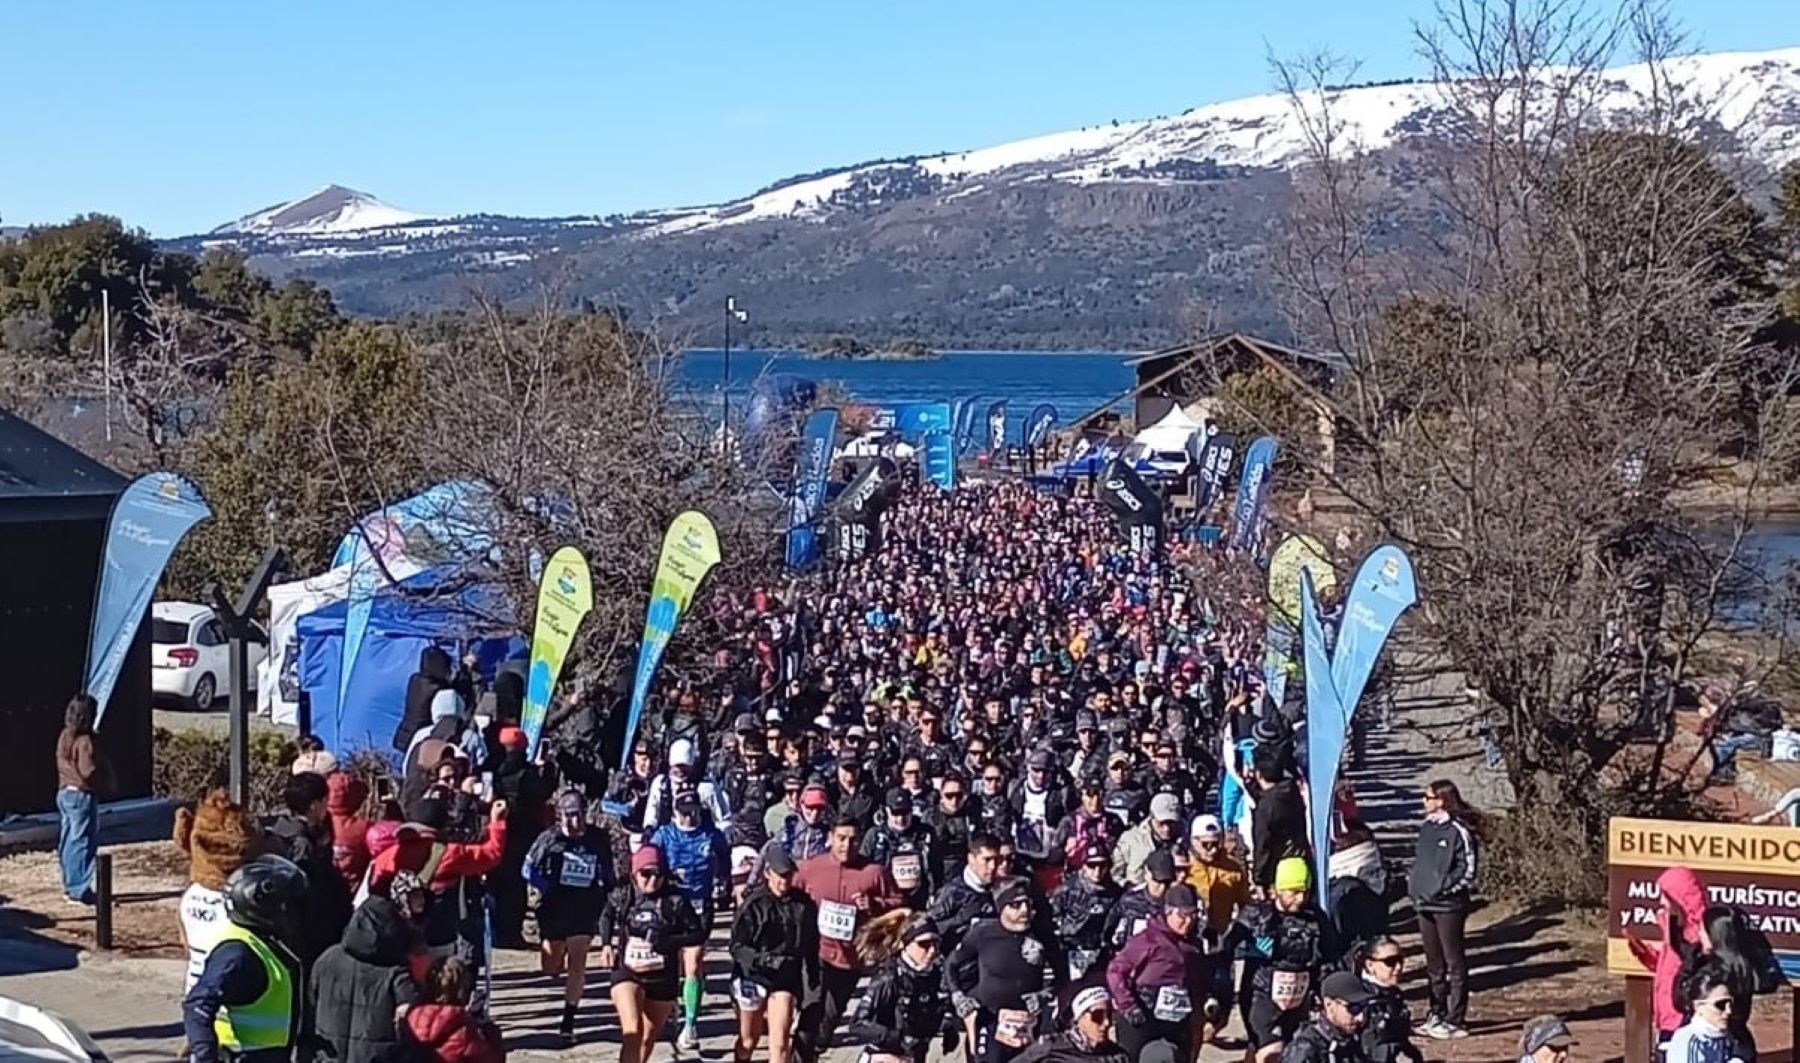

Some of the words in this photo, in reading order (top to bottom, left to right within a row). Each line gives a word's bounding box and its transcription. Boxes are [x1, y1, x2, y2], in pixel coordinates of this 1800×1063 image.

[1620, 831, 1800, 862] BIENVENIDO
[1628, 880, 1660, 899] MU
[1707, 882, 1800, 908] TURÍSTIC
[1620, 910, 1631, 926] y
